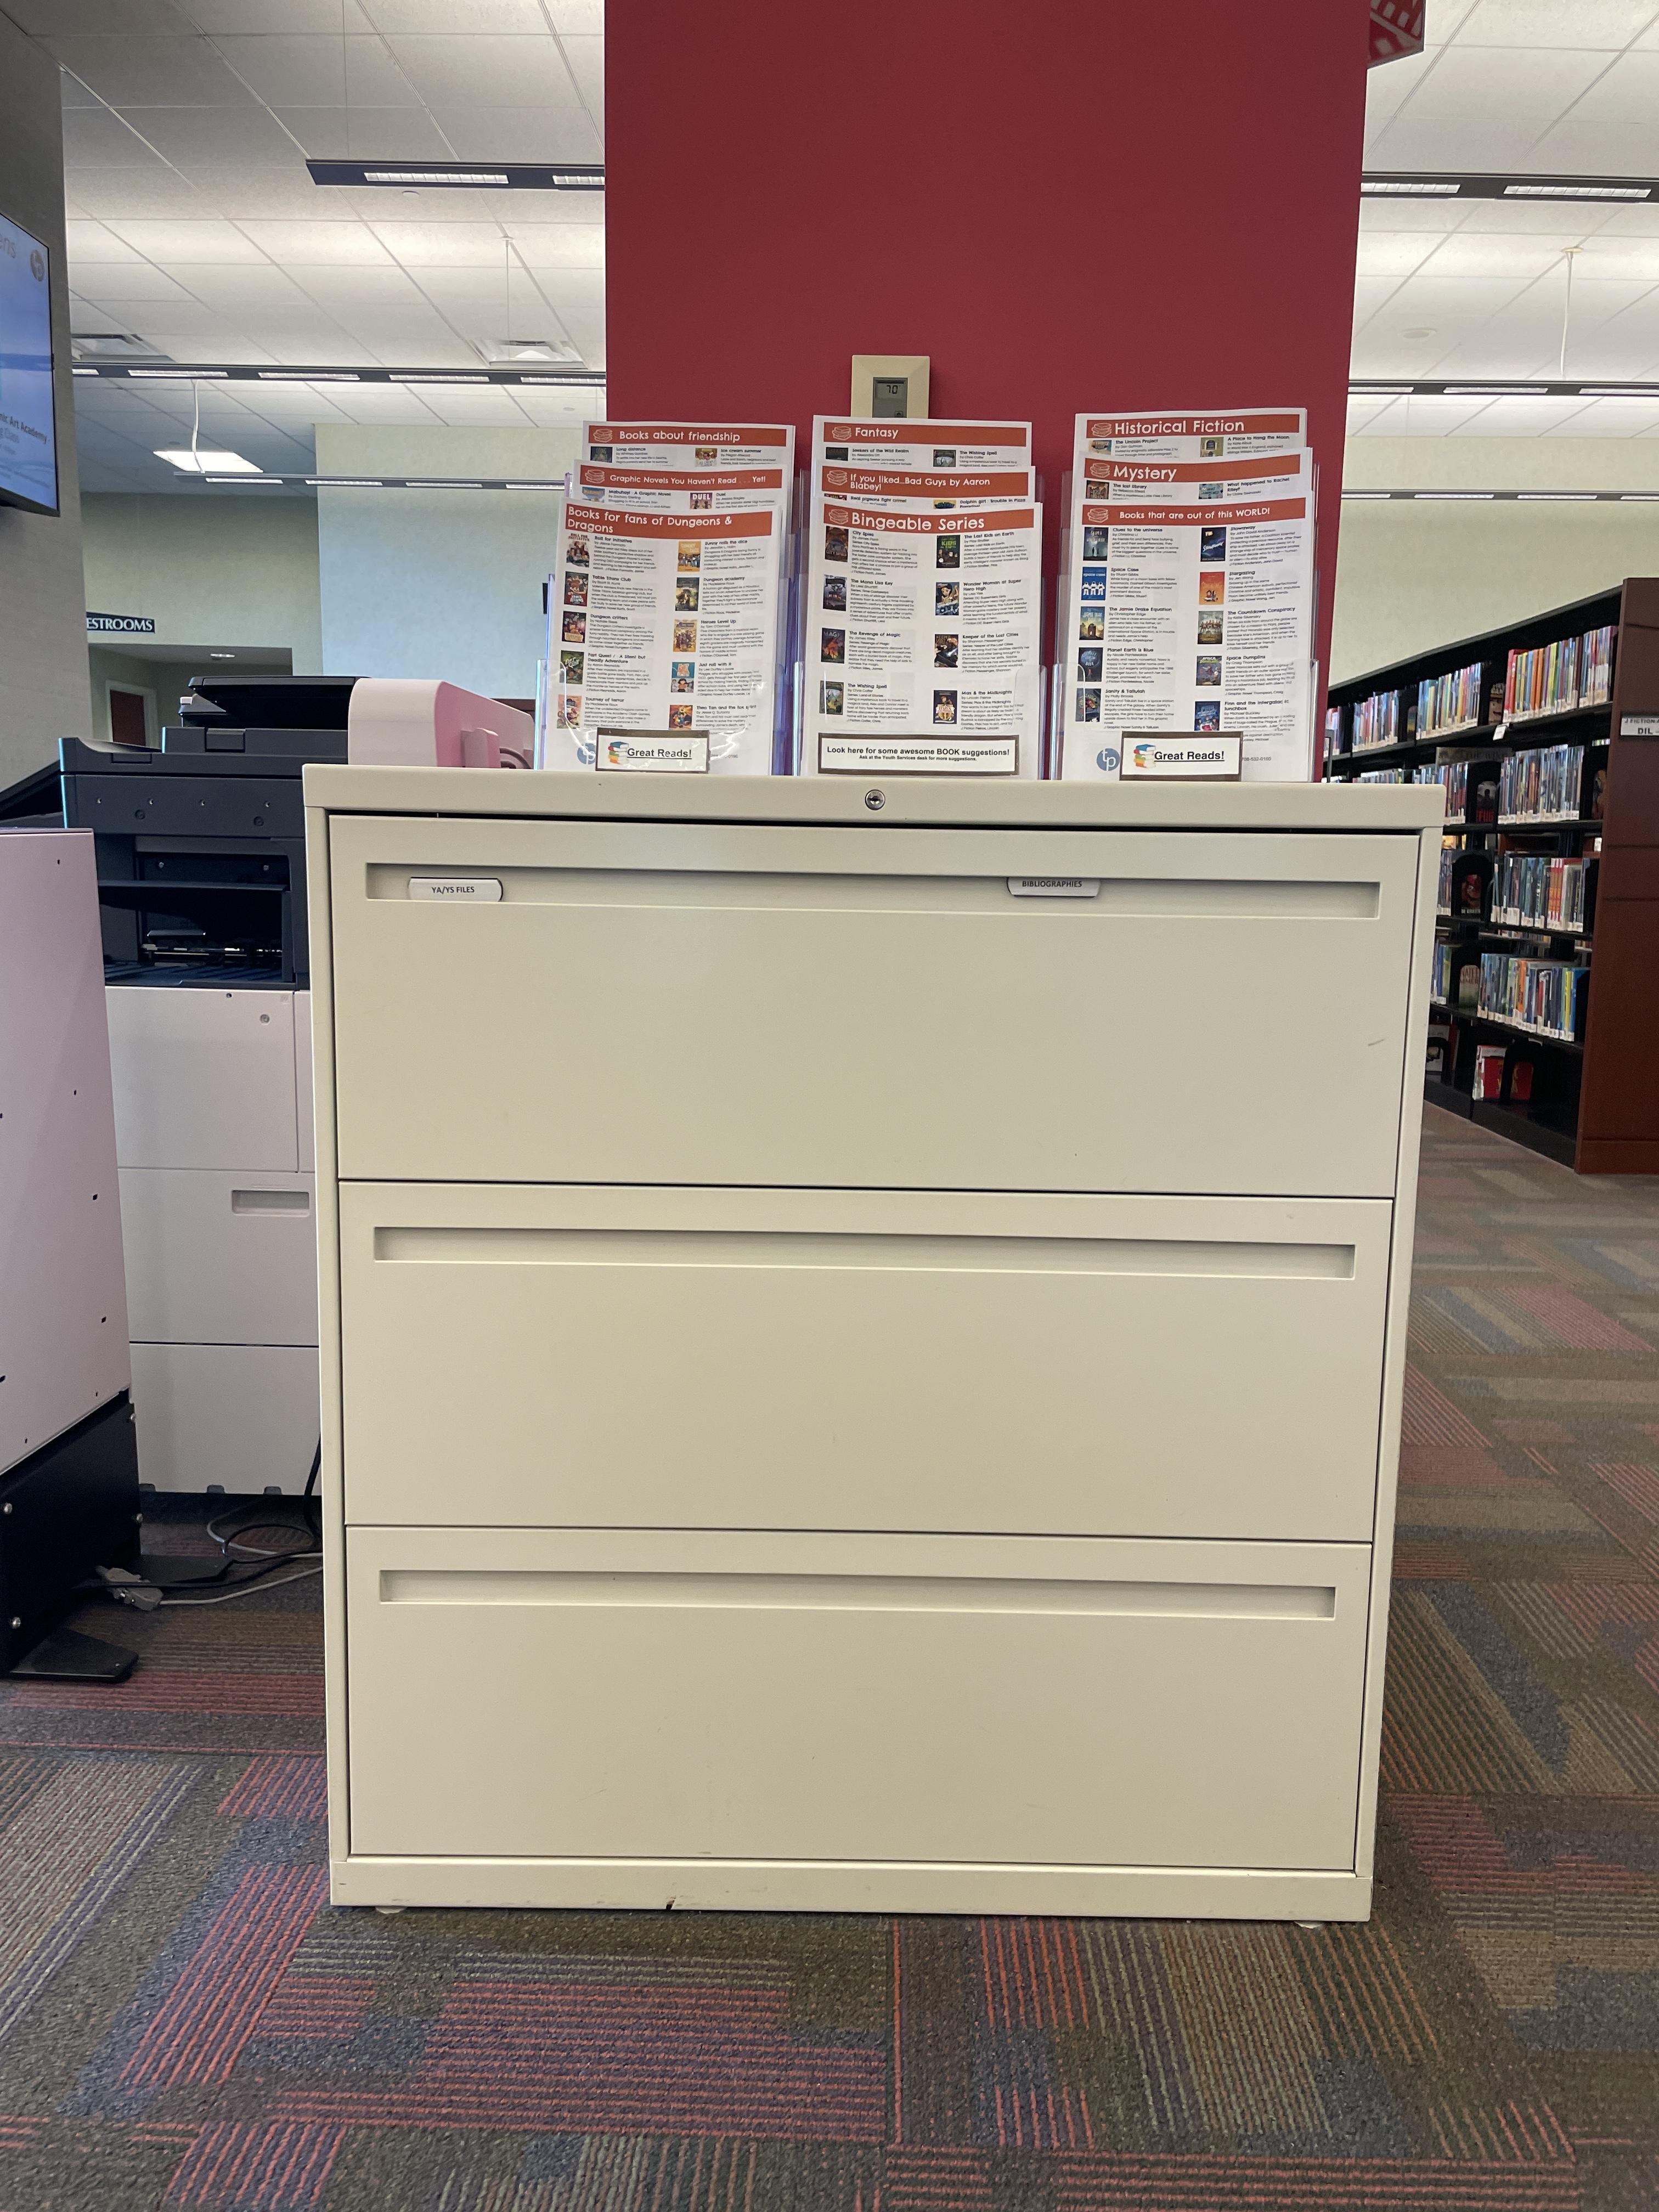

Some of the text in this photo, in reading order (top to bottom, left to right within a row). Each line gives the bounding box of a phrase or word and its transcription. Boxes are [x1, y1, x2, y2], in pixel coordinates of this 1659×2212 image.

[887, 385, 897, 394] 70
[855, 427, 898, 439] Fantasy
[1115, 420, 1245, 435] Historical Fiction
[620, 431, 740, 443] Books about friendship
[610, 475, 641, 483] Graphic
[1114, 465, 1177, 482] Mystery
[850, 483, 881, 492] Blabey!
[925, 478, 946, 487] Guys
[950, 478, 960, 487] by
[569, 507, 732, 528] Books for fans of Dungeons &
[1236, 508, 1270, 517] WORLD!
[568, 519, 613, 533] Dragons
[852, 512, 984, 531] Bingeable Series
[86, 618, 153, 631] ESTROOMS
[627, 748, 692, 758] Great Reads!
[1188, 751, 1224, 760] Reads!
